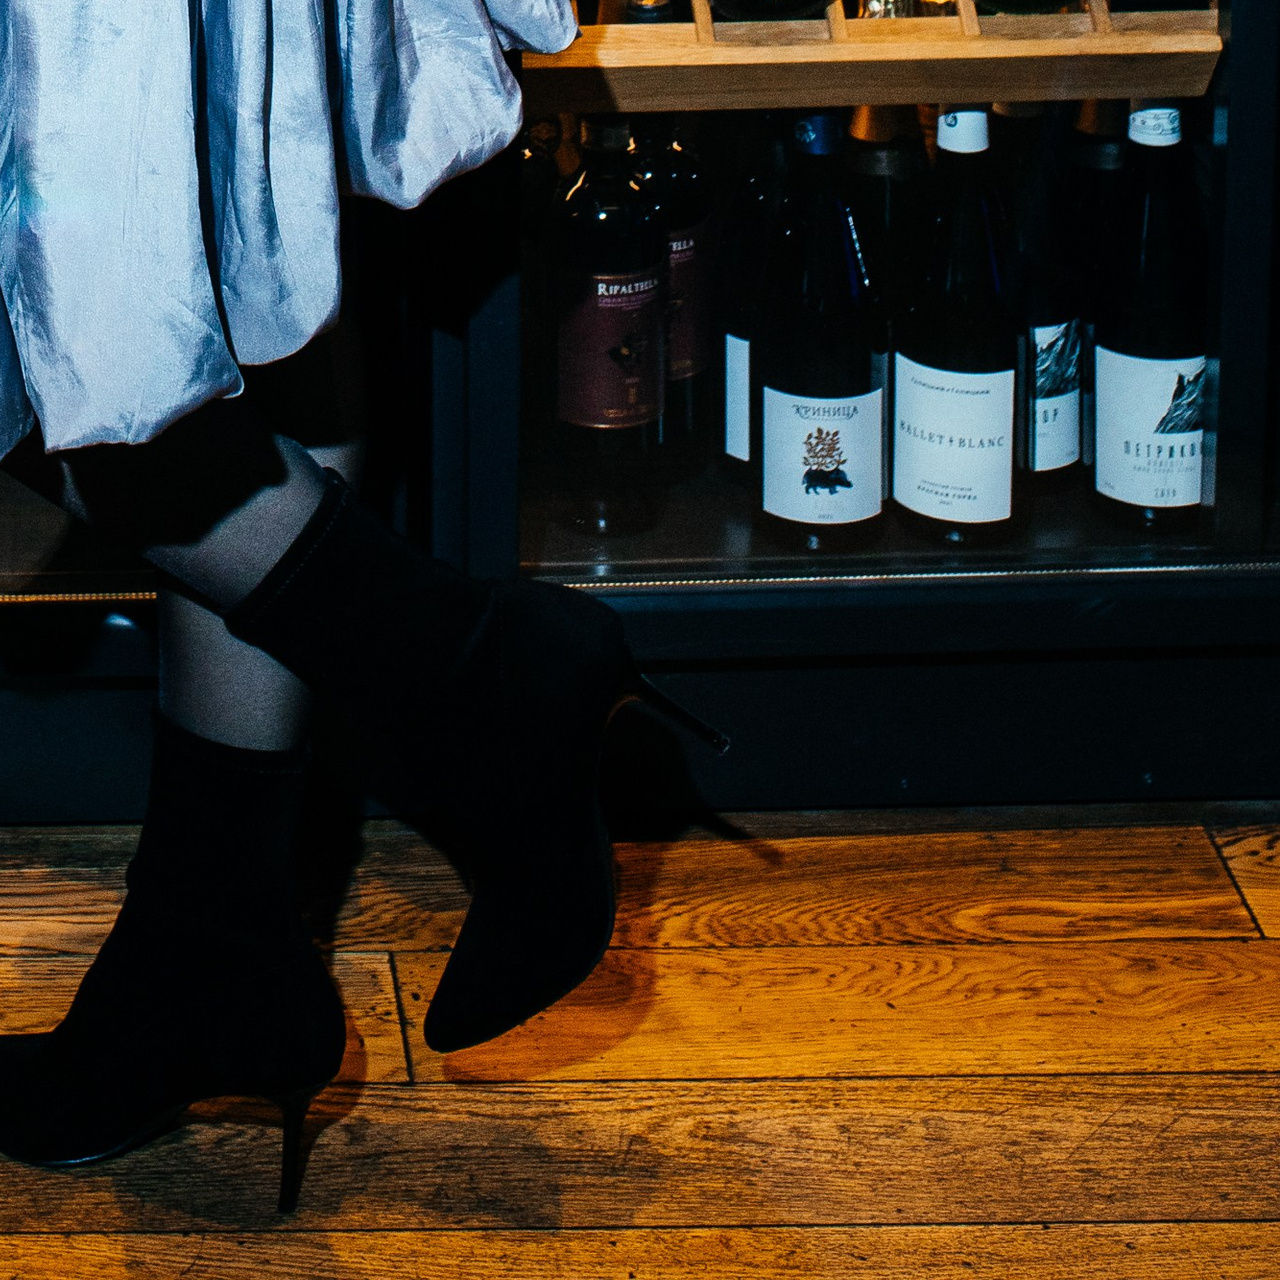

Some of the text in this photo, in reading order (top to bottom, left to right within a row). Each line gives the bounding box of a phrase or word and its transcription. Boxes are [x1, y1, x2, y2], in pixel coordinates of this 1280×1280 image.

[792, 404, 860, 421] КРИНИЦА
[899, 419, 1006, 450] BALLET BLANC
[1123, 440, 1198, 459] ПЕТРИКО
